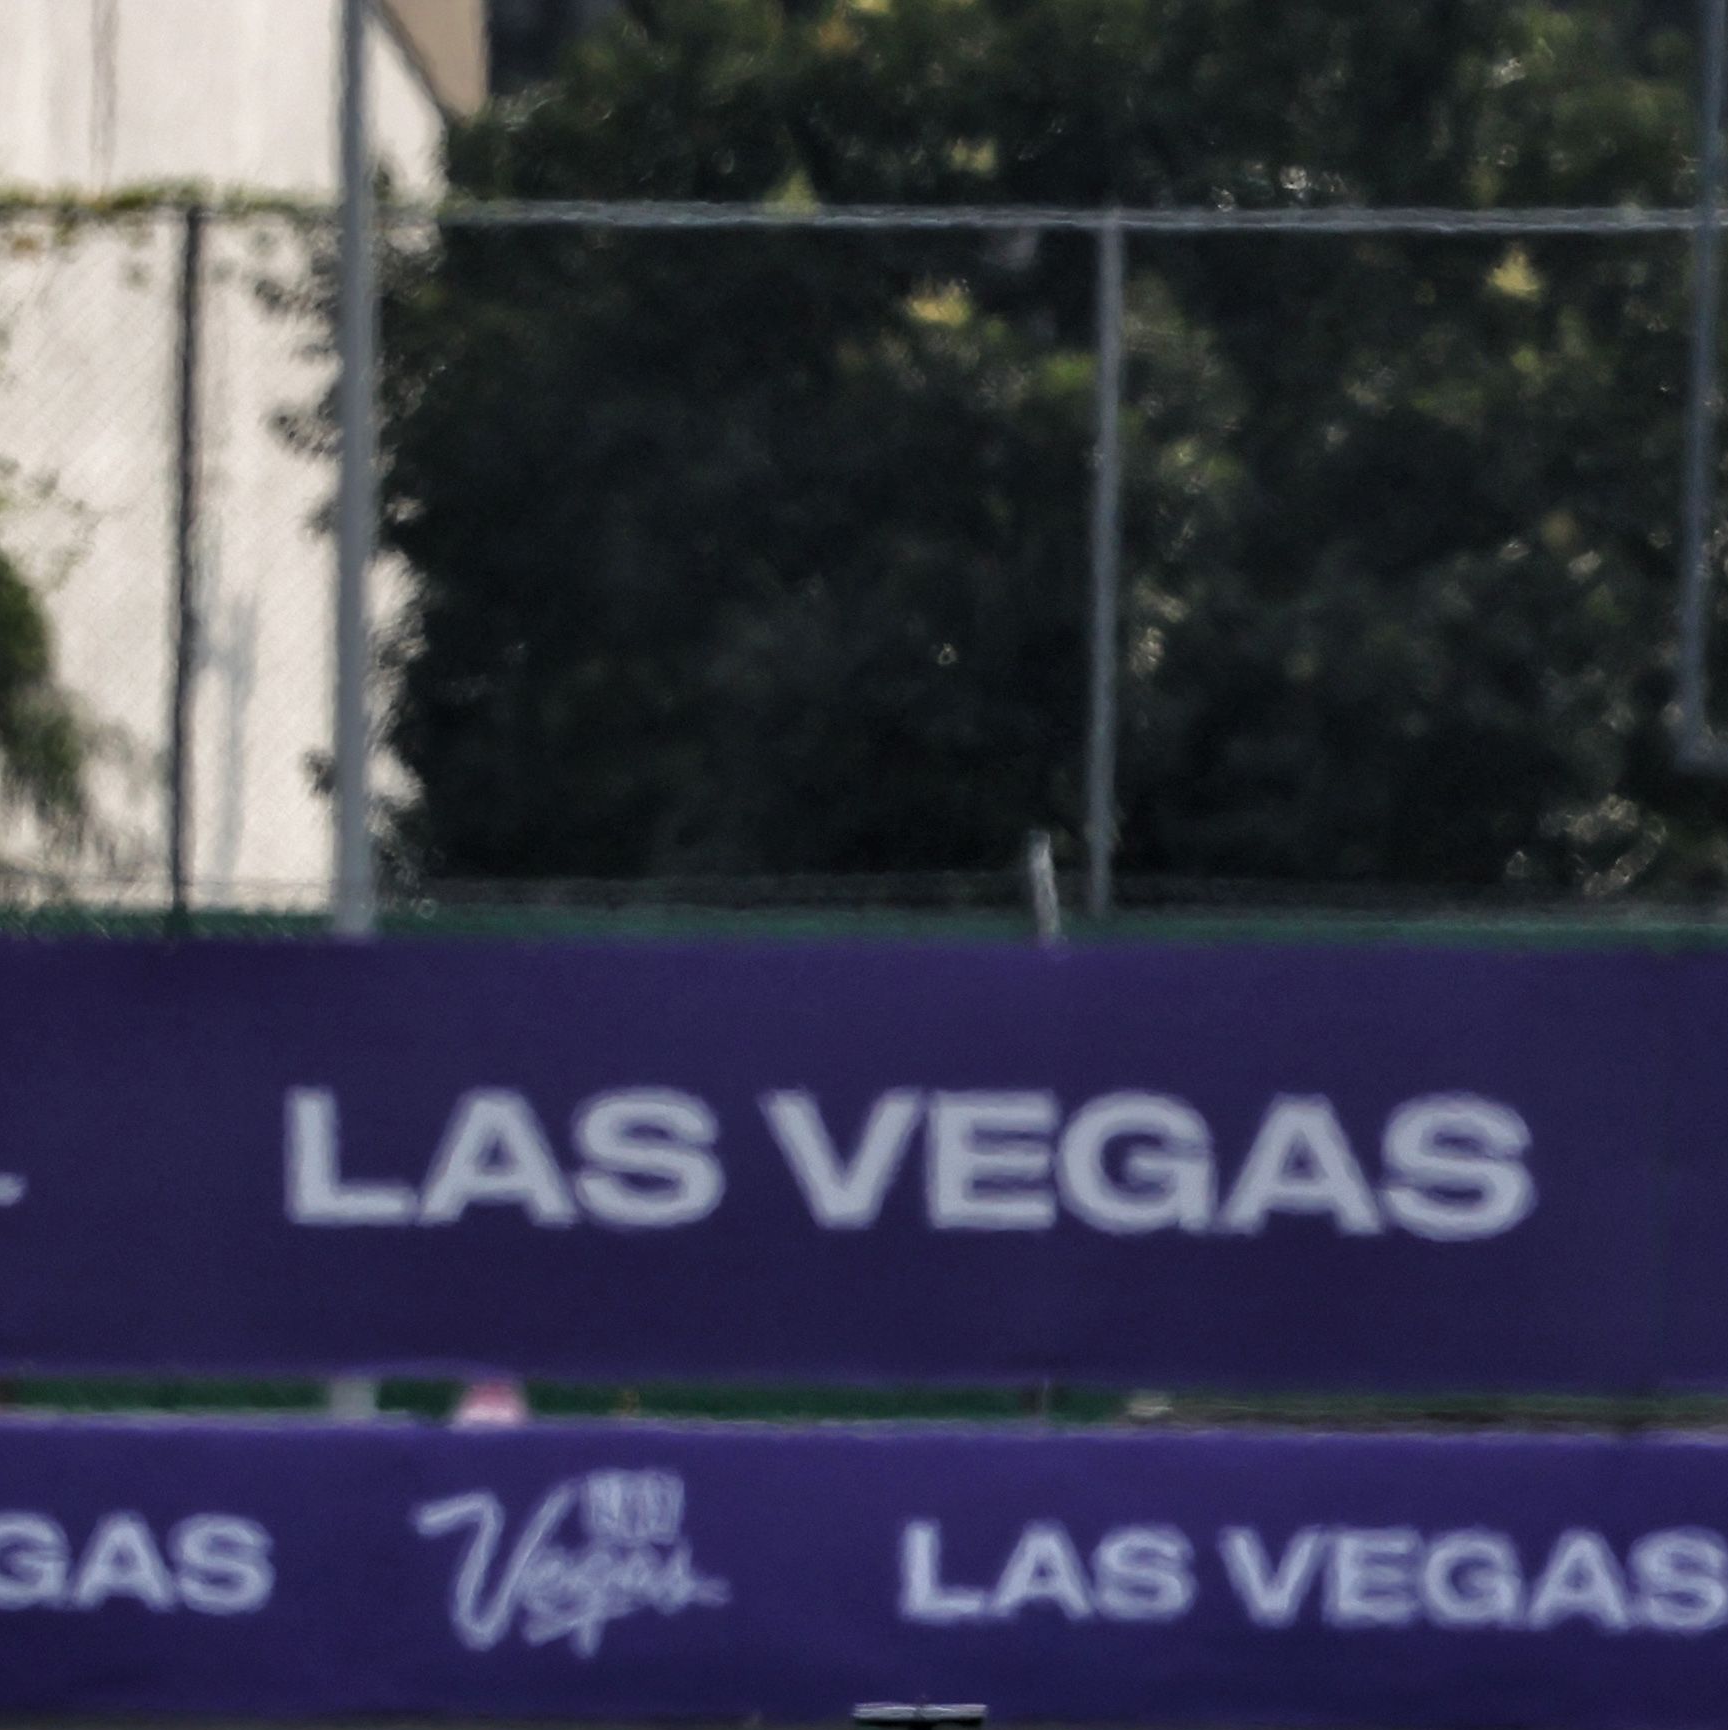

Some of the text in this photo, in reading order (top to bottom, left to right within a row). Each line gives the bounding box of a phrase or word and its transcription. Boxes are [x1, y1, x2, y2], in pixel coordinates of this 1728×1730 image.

[283, 1086, 1536, 1240] LAS VEGAS
[898, 1520, 1728, 1635] LAS VEGAS
